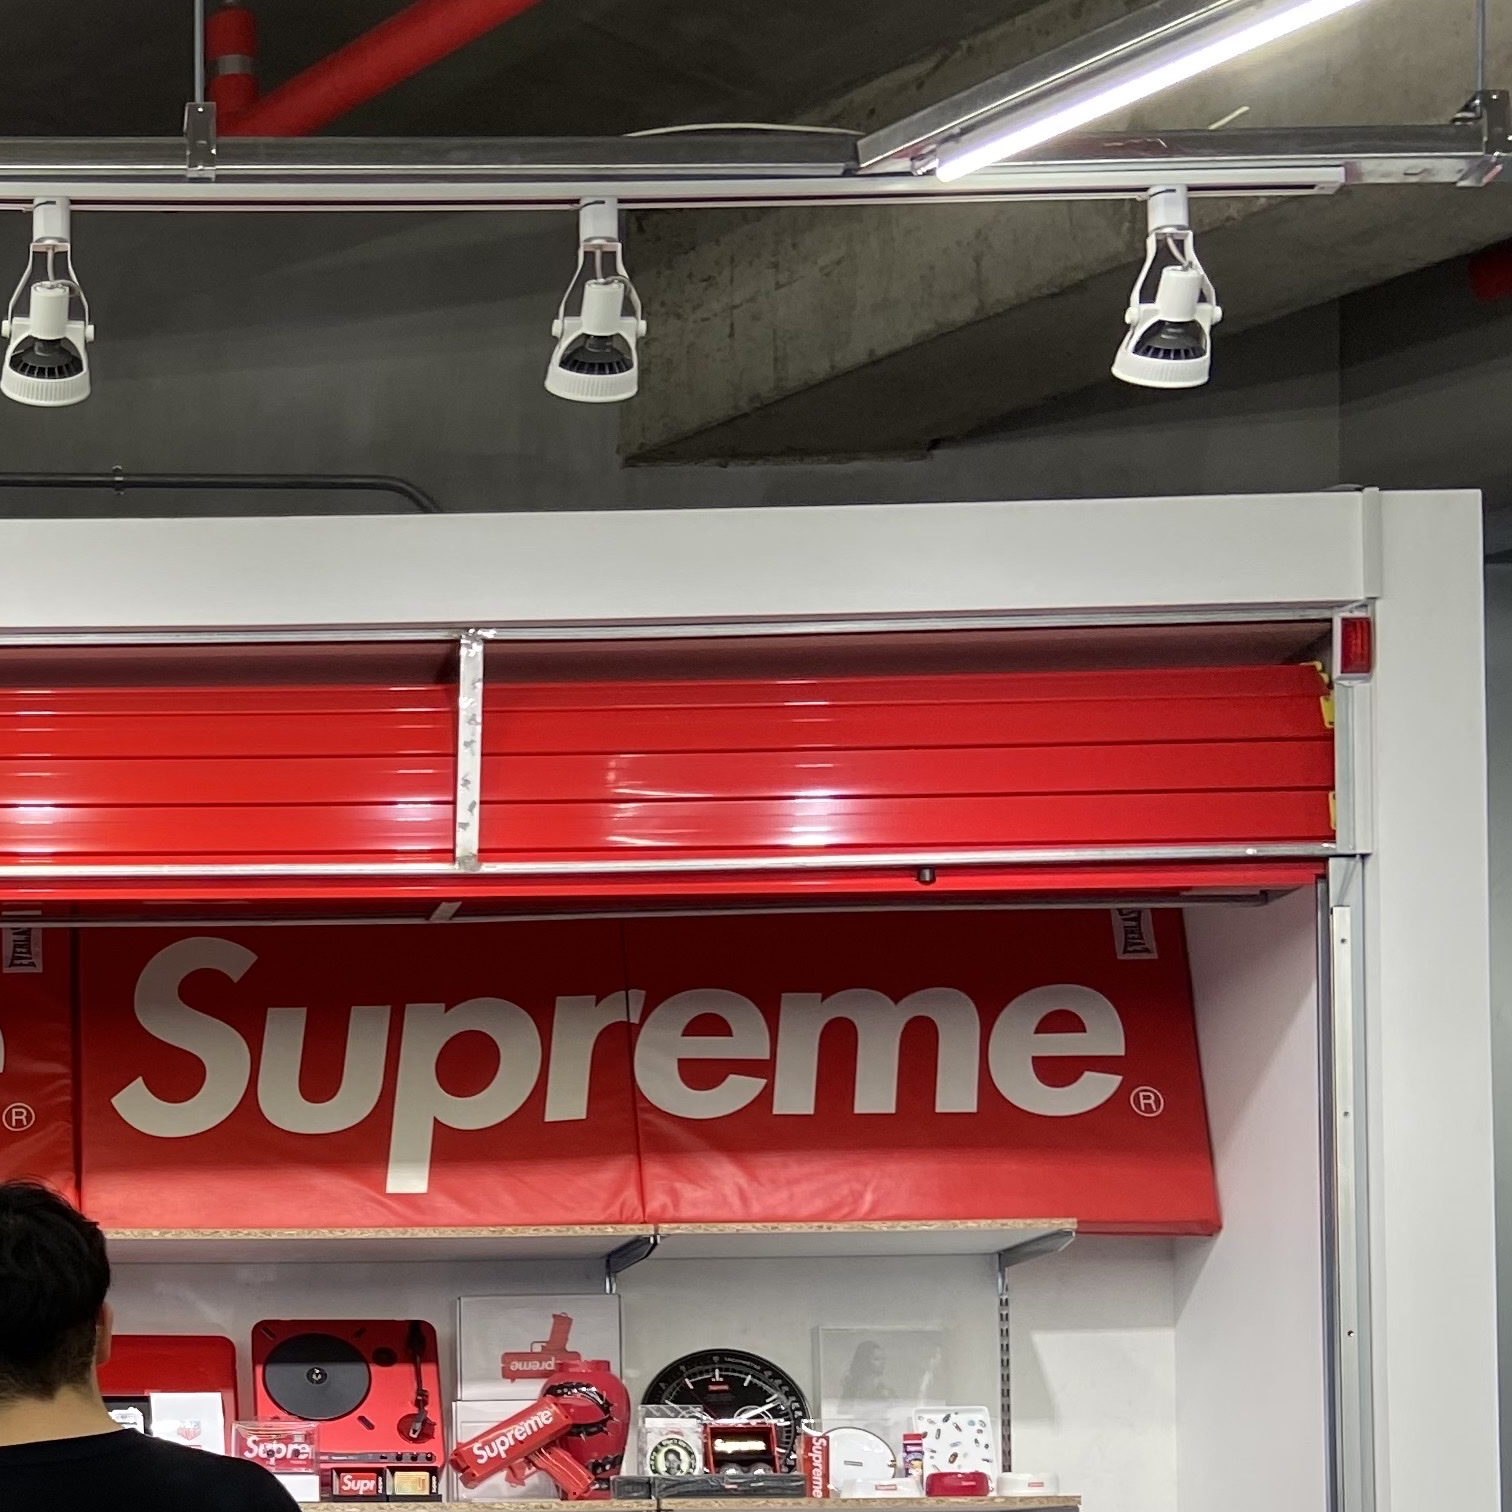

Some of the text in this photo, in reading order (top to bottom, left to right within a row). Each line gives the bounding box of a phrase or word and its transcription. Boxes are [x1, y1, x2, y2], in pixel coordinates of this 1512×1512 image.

[111, 936, 1126, 1194] Supreme
[472, 1408, 553, 1464] Supreme
[812, 1437, 827, 1498] Supreme
